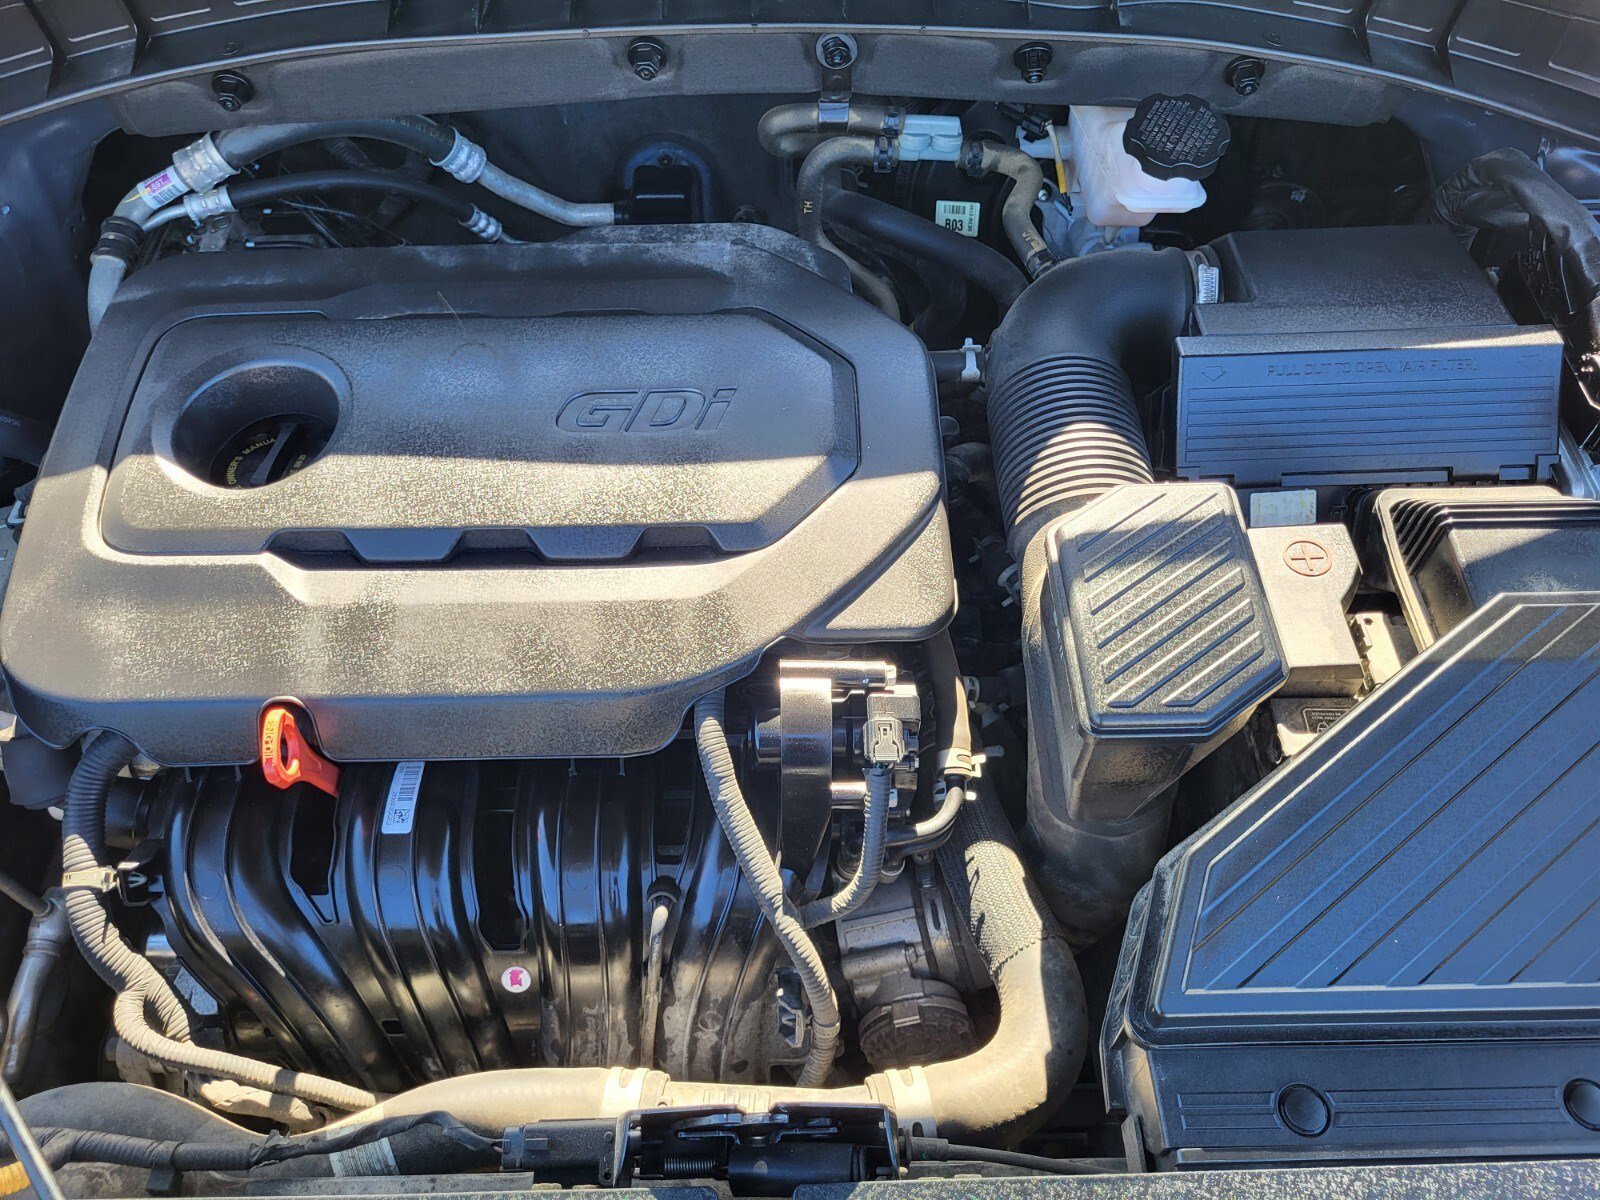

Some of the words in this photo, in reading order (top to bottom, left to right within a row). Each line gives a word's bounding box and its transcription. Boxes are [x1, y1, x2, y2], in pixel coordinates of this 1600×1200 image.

[1267, 364, 1300, 377] PULL
[1304, 363, 1332, 376] OUT
[1335, 361, 1351, 374] TO
[1356, 360, 1392, 374] OPEN
[242, 438, 277, 455] MANUA
